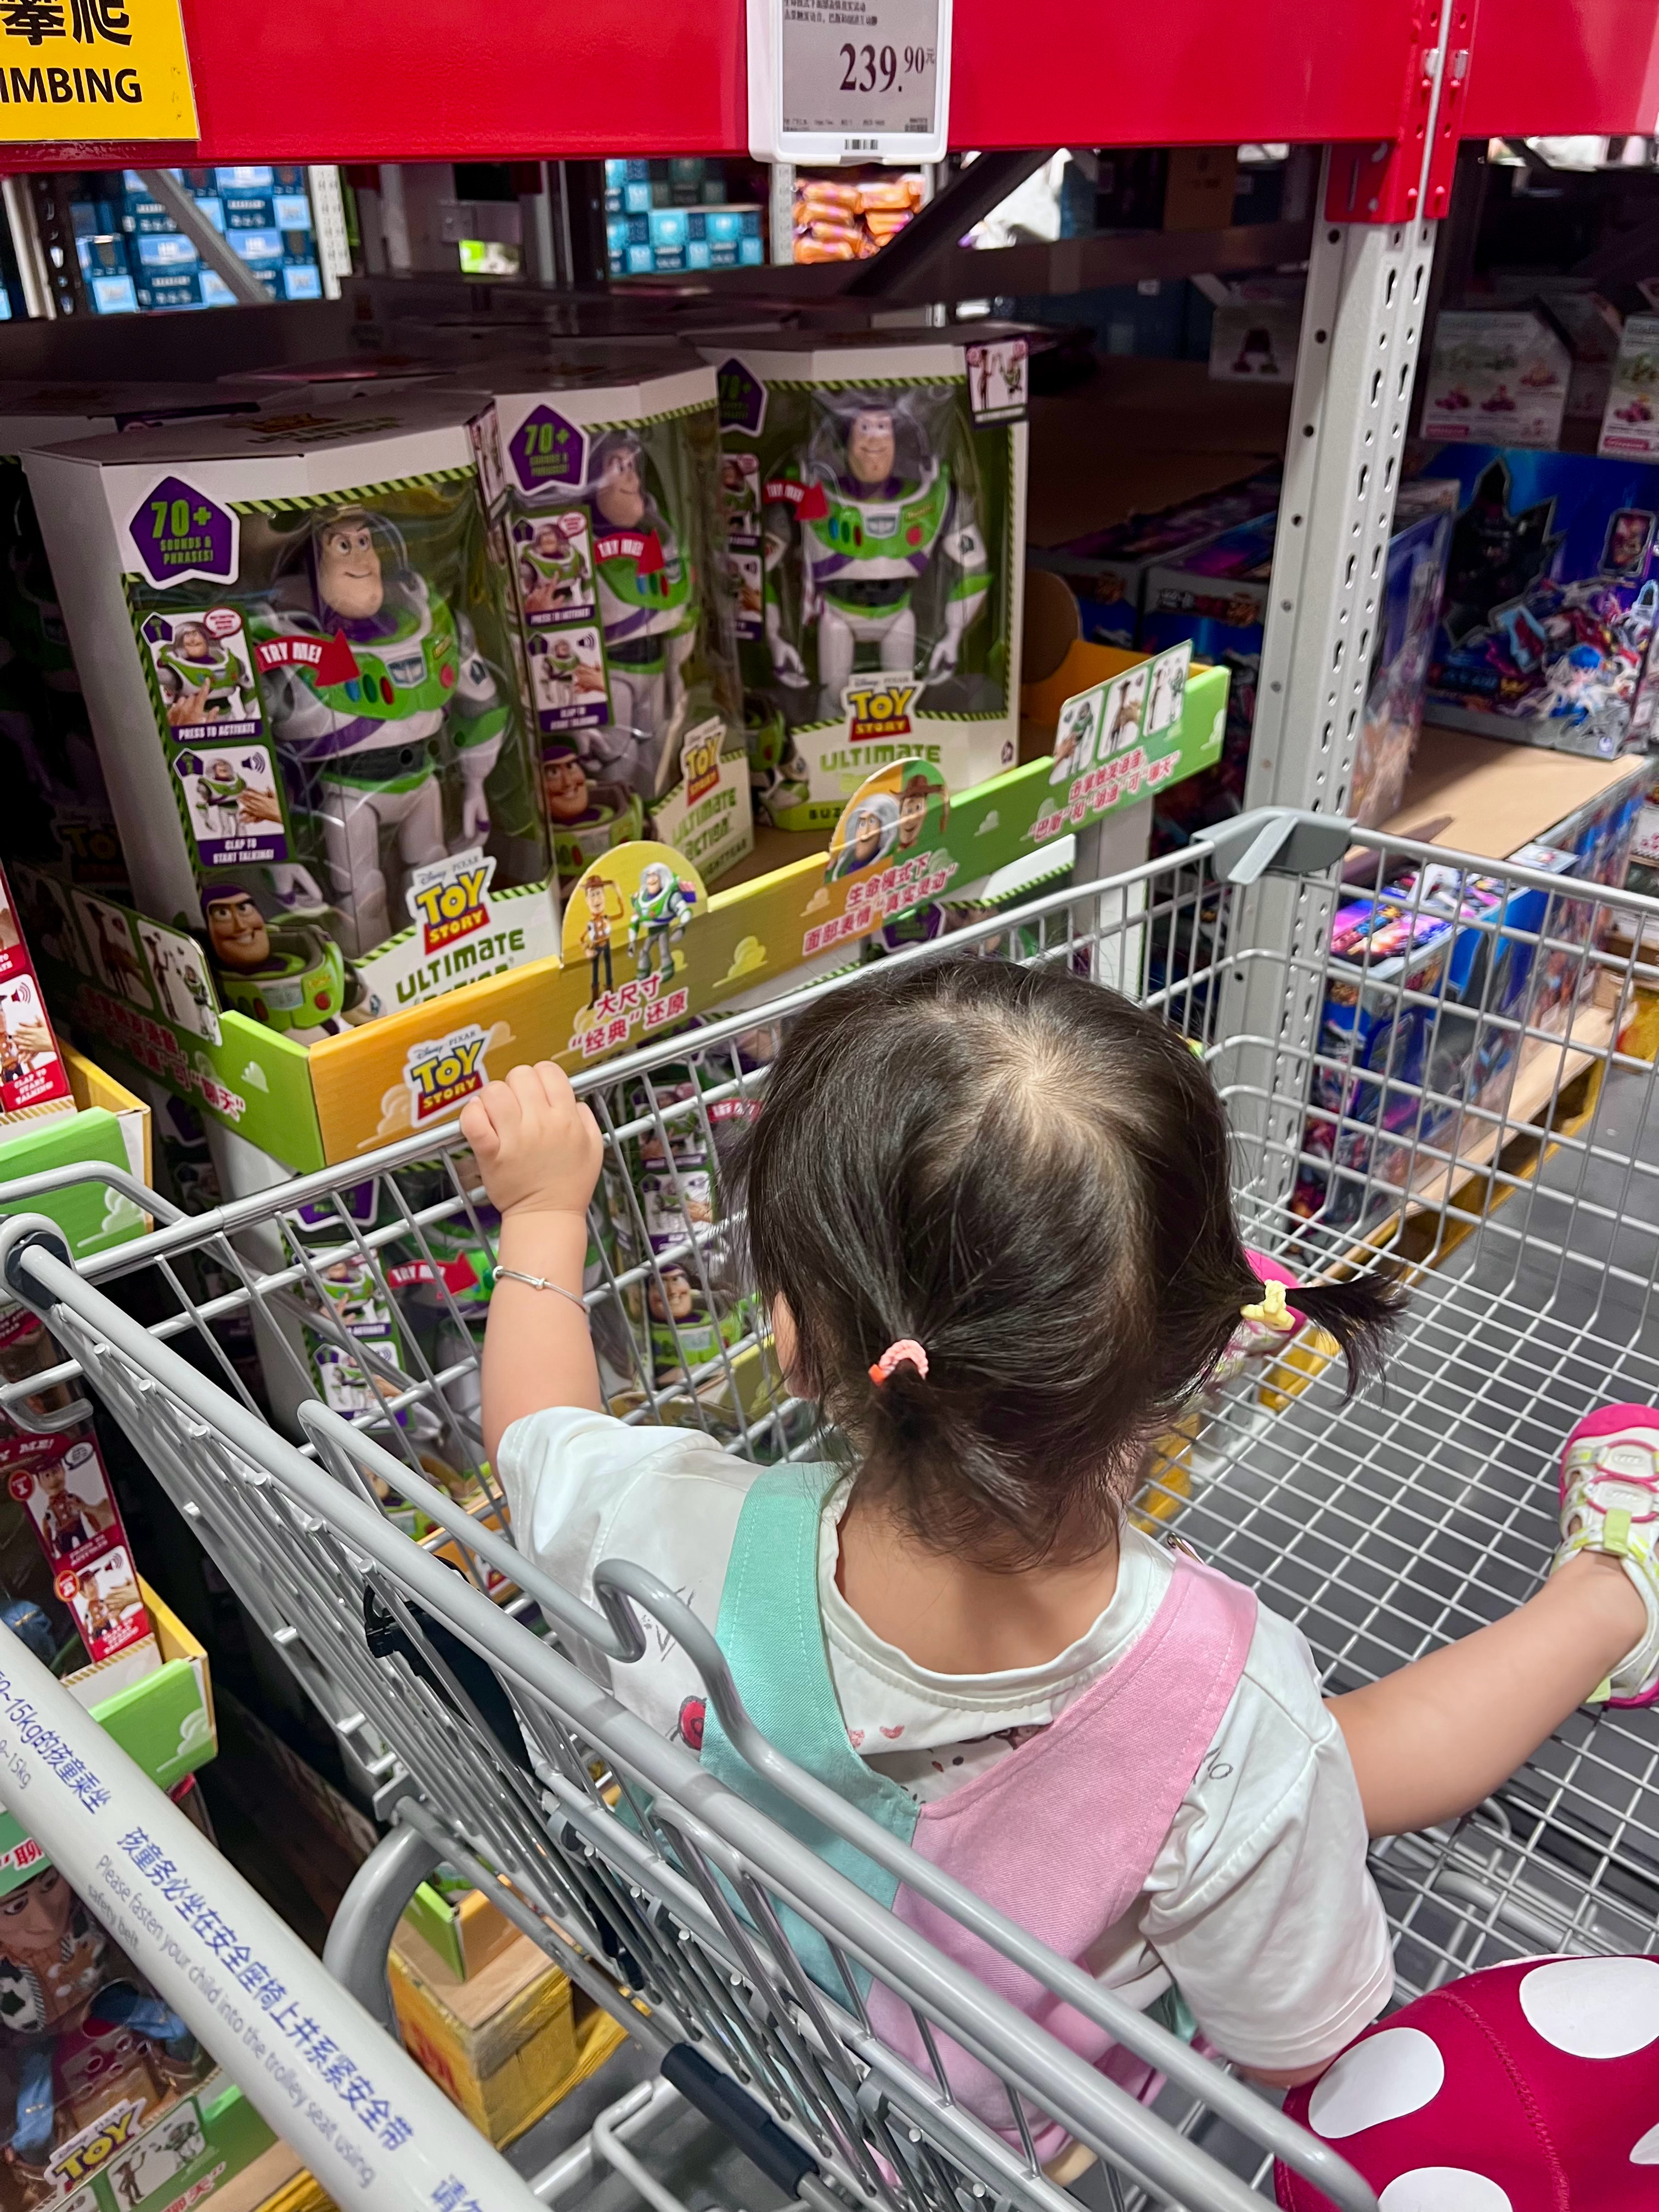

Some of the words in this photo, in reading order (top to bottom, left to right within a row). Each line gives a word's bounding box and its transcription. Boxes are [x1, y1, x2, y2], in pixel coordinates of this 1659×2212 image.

[0, 67, 143, 103] IMBING
[151, 499, 212, 538] 70+
[260, 642, 288, 664] TRY
[292, 642, 323, 664] ME!
[848, 686, 917, 721] TOY
[179, 726, 202, 740] PRESS
[205, 726, 217, 737] TO
[218, 723, 256, 737] ACTIVATE
[855, 722, 905, 735] STORY
[819, 744, 941, 772] ULTIMATE
[224, 839, 245, 850] CLAP
[247, 838, 257, 849] TO
[415, 865, 489, 926] TOY
[848, 853, 931, 906] 生命模式下
[429, 910, 484, 944] STORY
[396, 928, 526, 1004] ULTIMATE
[596, 973, 662, 1020] 大尺寸
[410, 1036, 487, 1097] TOY
[423, 1077, 476, 1110] STORY
[87, 1883, 117, 1927] safety
[95, 1855, 131, 1903] Please
[128, 1893, 163, 1940] fasten
[157, 1934, 191, 1970] your
[189, 1966, 223, 2005] child
[217, 1994, 244, 2033] into
[242, 2027, 266, 2059] the
[304, 2102, 338, 2141] seat
[53, 2106, 138, 2181] TOY
